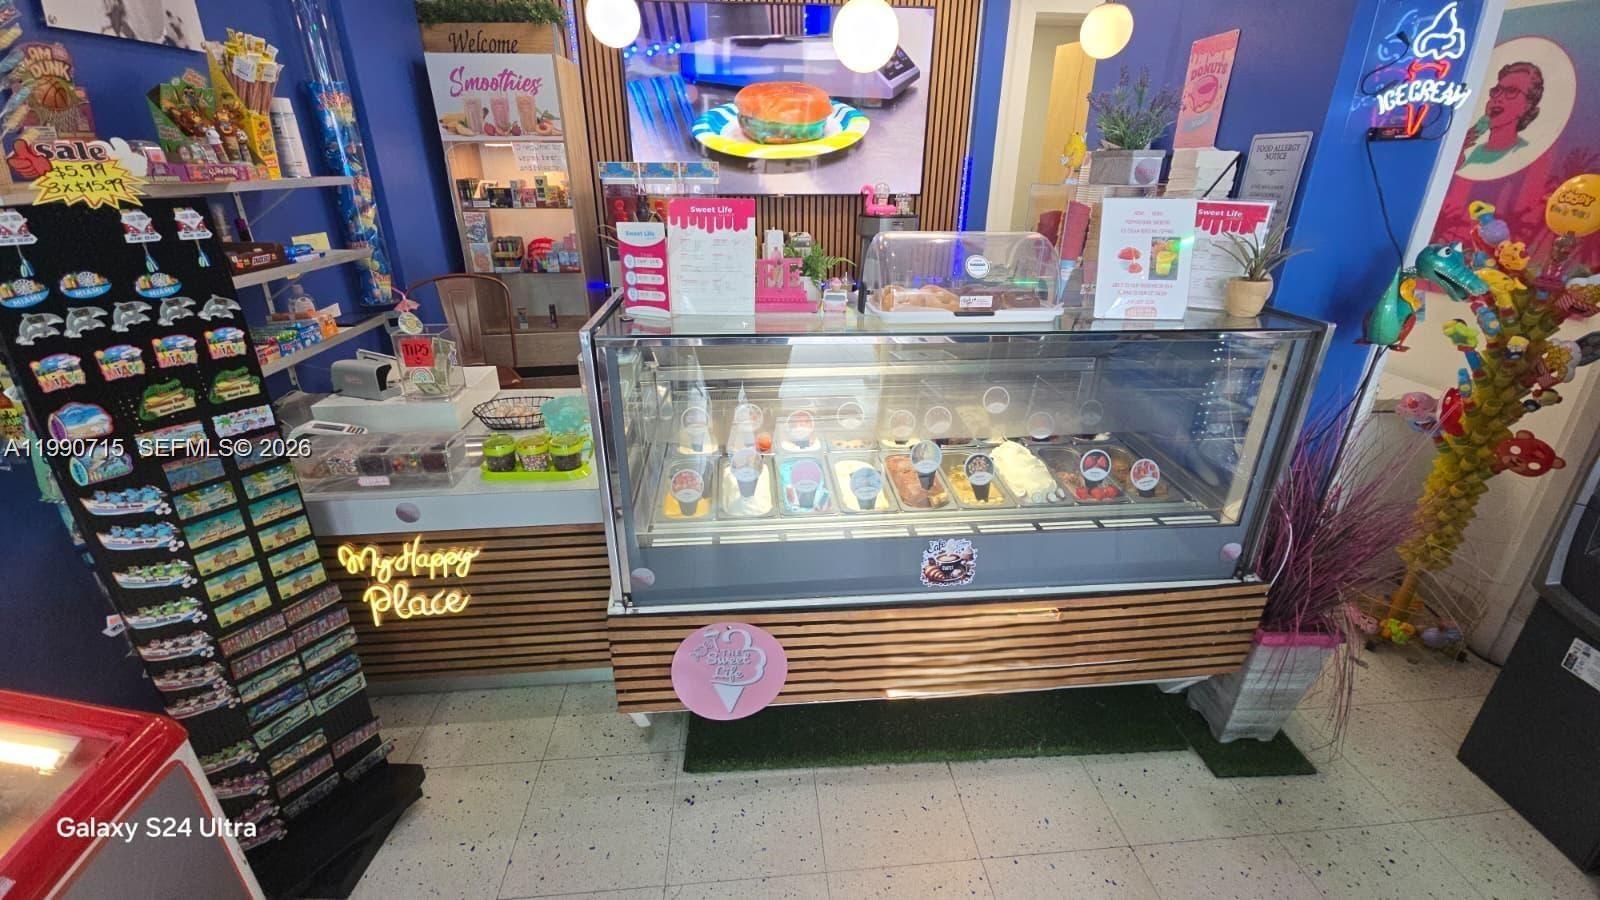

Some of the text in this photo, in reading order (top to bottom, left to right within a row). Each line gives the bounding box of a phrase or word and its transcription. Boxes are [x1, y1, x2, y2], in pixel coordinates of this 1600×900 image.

[449, 30, 519, 53] Welcome
[30, 61, 70, 81] DUNK
[449, 66, 542, 97] Smoothies
[1377, 83, 1408, 115] ICE
[35, 142, 107, 161] sale
[53, 163, 107, 179] $5.99
[13, 294, 41, 306] MIAMI
[75, 287, 103, 297] MIAMI
[149, 287, 175, 297] MIAMI
[402, 344, 429, 356] TIPS
[337, 534, 482, 583] My Happy
[362, 580, 472, 627] Place
